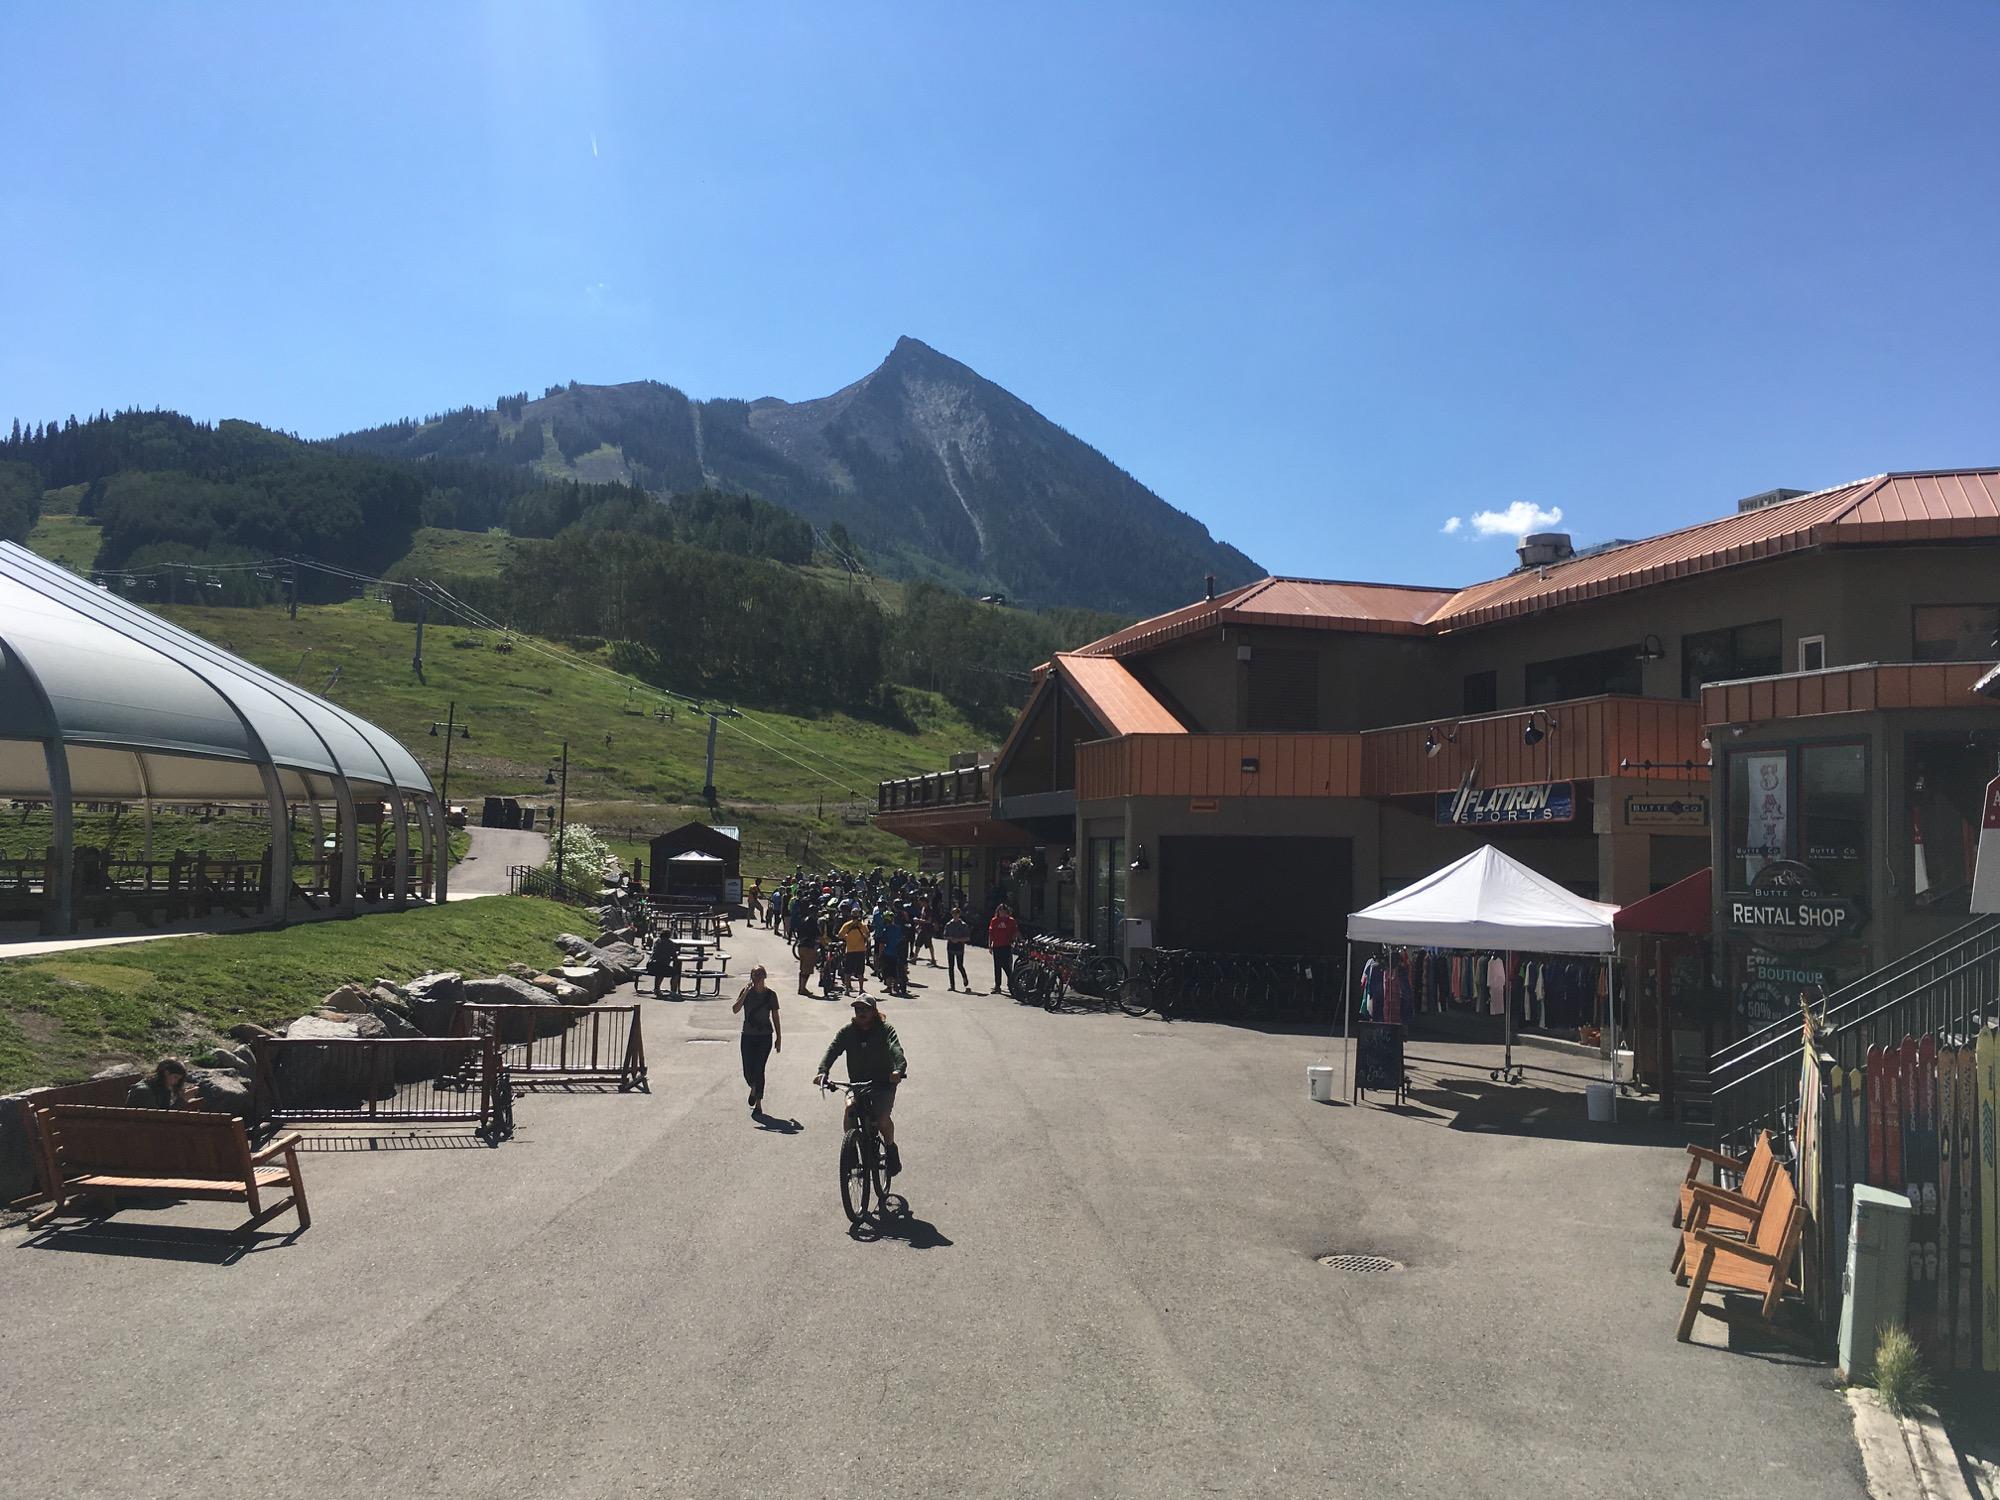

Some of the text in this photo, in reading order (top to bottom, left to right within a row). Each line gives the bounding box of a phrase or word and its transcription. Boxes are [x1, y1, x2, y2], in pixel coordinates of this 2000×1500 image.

[1464, 784, 1552, 813] FLATIRON
[1460, 808, 1553, 824] SPORTS
[1732, 903, 1846, 927] RENTAL SHOP
[1758, 966, 1824, 985] BOUTIQUE
